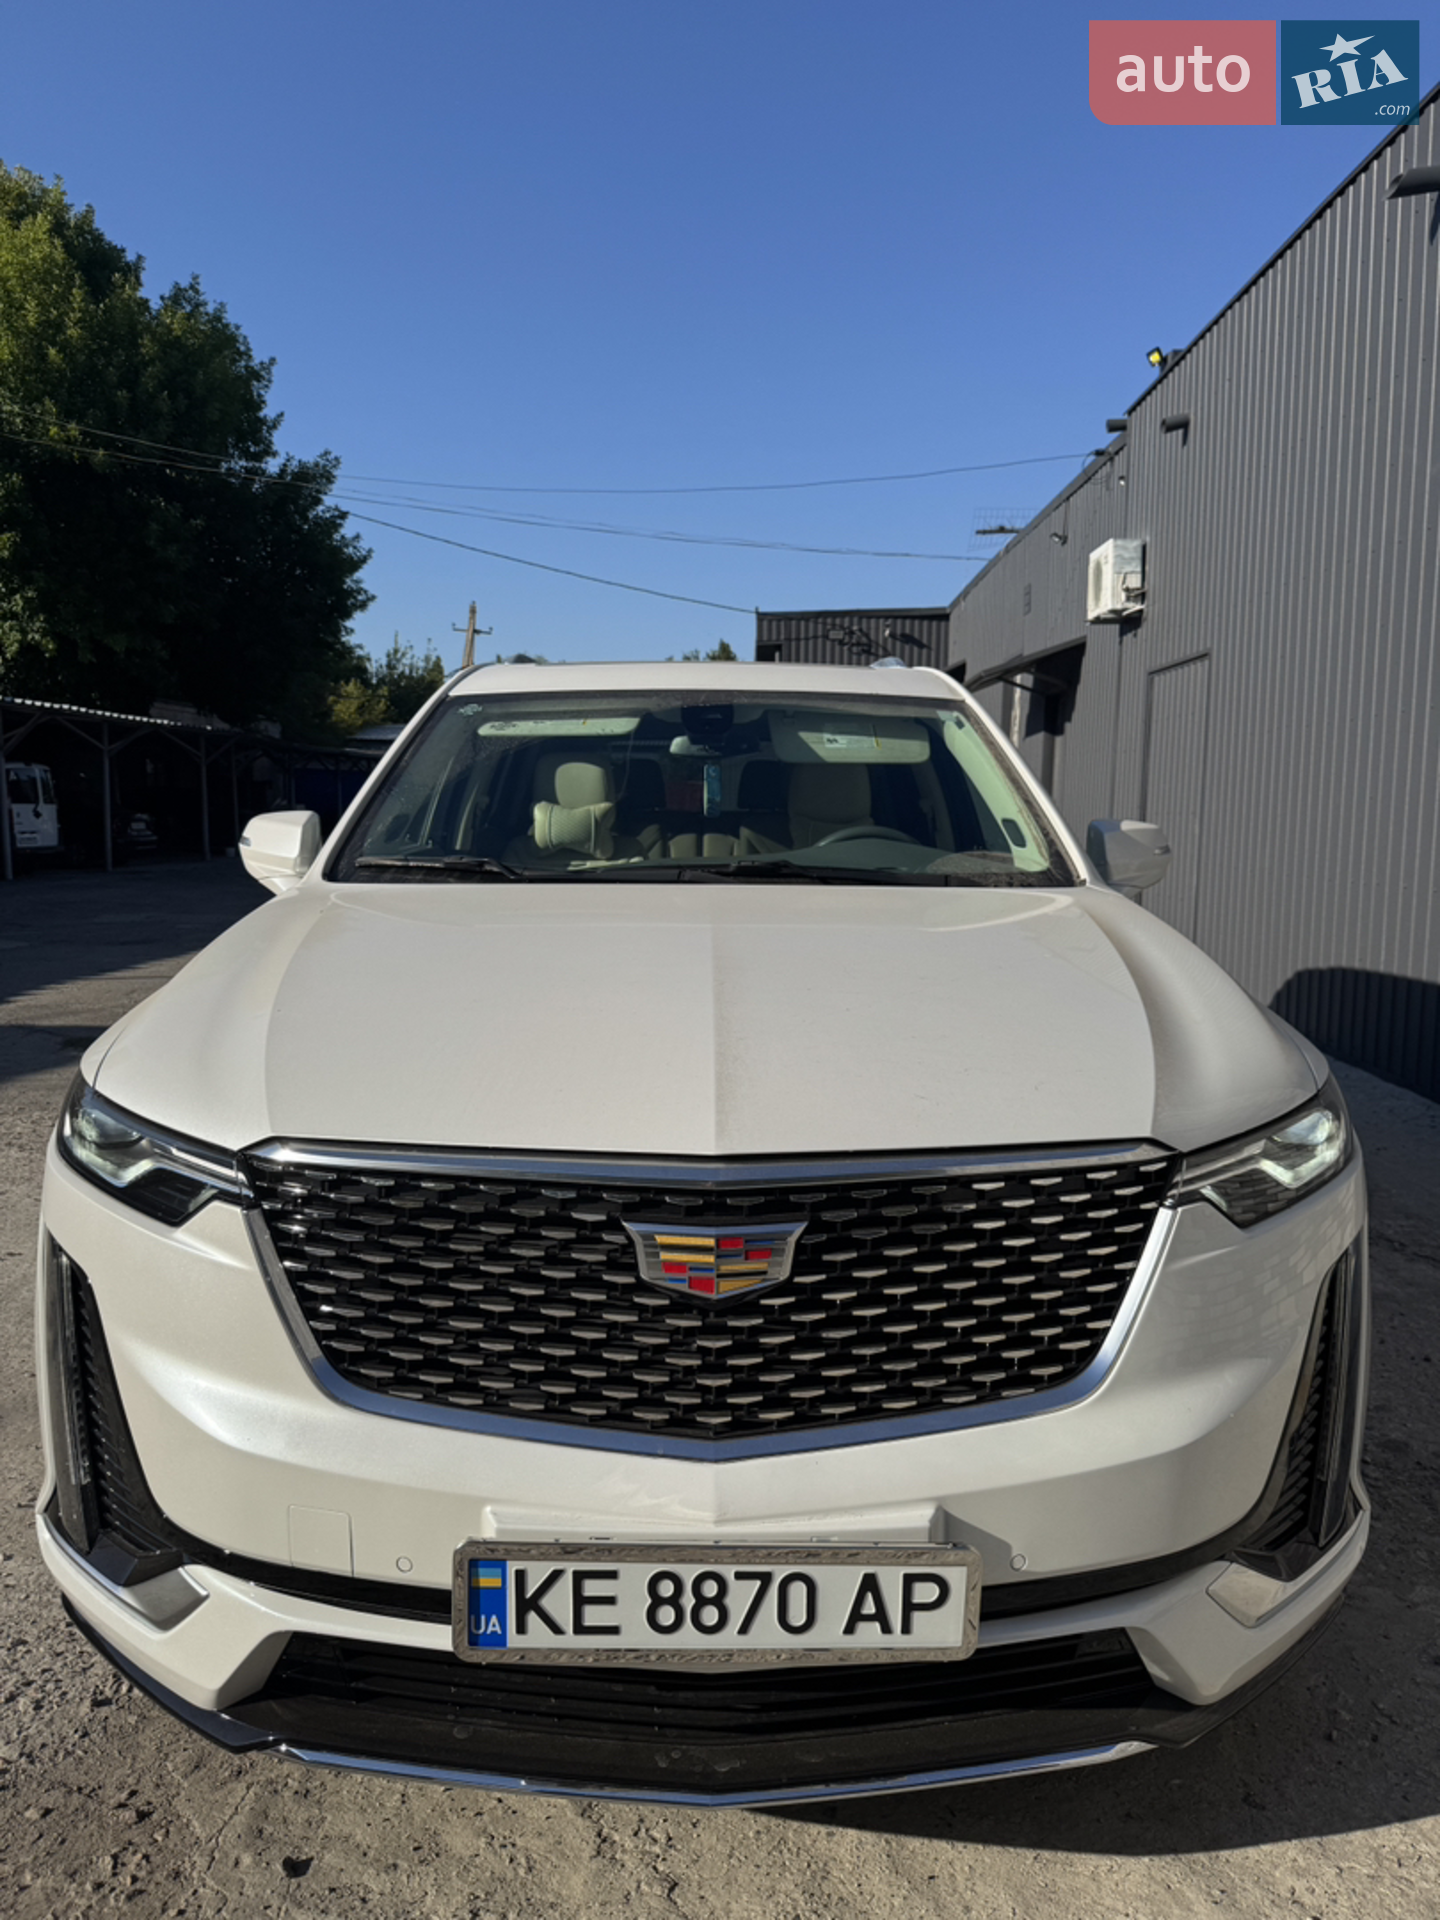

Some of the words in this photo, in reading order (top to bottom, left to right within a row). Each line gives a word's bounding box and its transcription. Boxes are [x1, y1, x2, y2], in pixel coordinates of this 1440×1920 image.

[470, 1614, 502, 1635] UA
[513, 1569, 620, 1635] KE
[645, 1570, 817, 1636] 8870
[842, 1572, 950, 1636] AP
